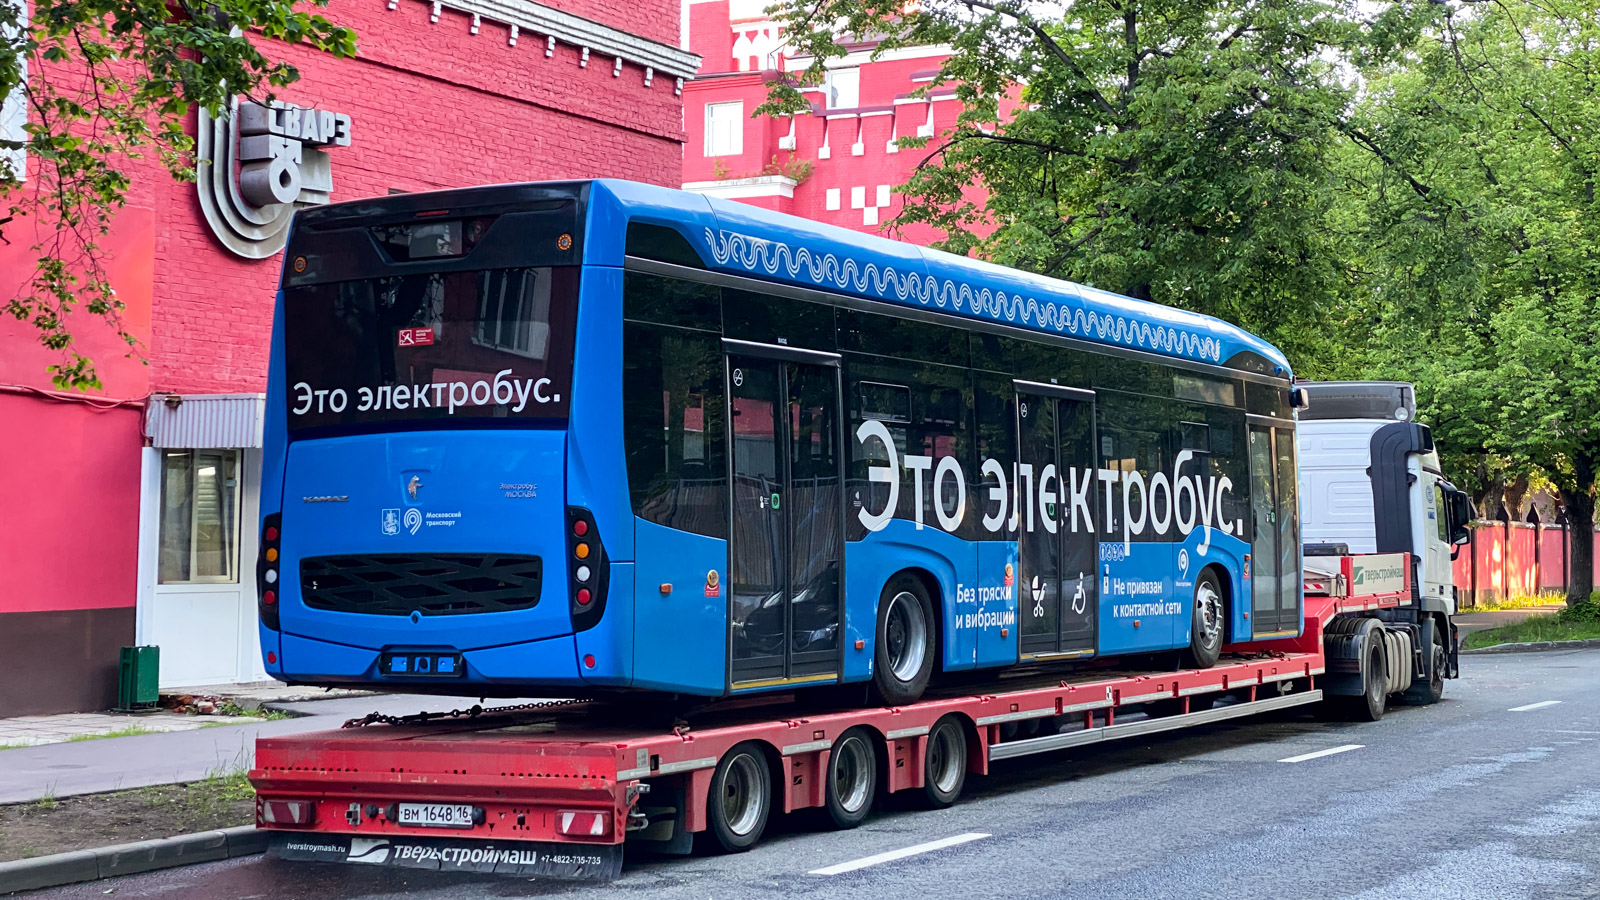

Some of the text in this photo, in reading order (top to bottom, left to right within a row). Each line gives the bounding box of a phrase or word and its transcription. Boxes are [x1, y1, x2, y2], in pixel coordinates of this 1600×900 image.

[269, 99, 351, 147] СВАРЗ
[292, 368, 561, 415] Это электробус.
[856, 420, 1243, 556] Это электробус.
[956, 583, 1012, 603] Без тряски
[1113, 578, 1126, 595] Не
[1126, 580, 1163, 597] привязан
[1113, 599, 1182, 618] к контактной сети
[955, 607, 1015, 632] и вибраций
[423, 805, 453, 822] 1648
[457, 806, 469, 819] 16
[287, 842, 346, 853] tverstroymash.ru
[394, 844, 537, 867] тверьстроймаш
[541, 854, 601, 865] +7-4822-735-735
